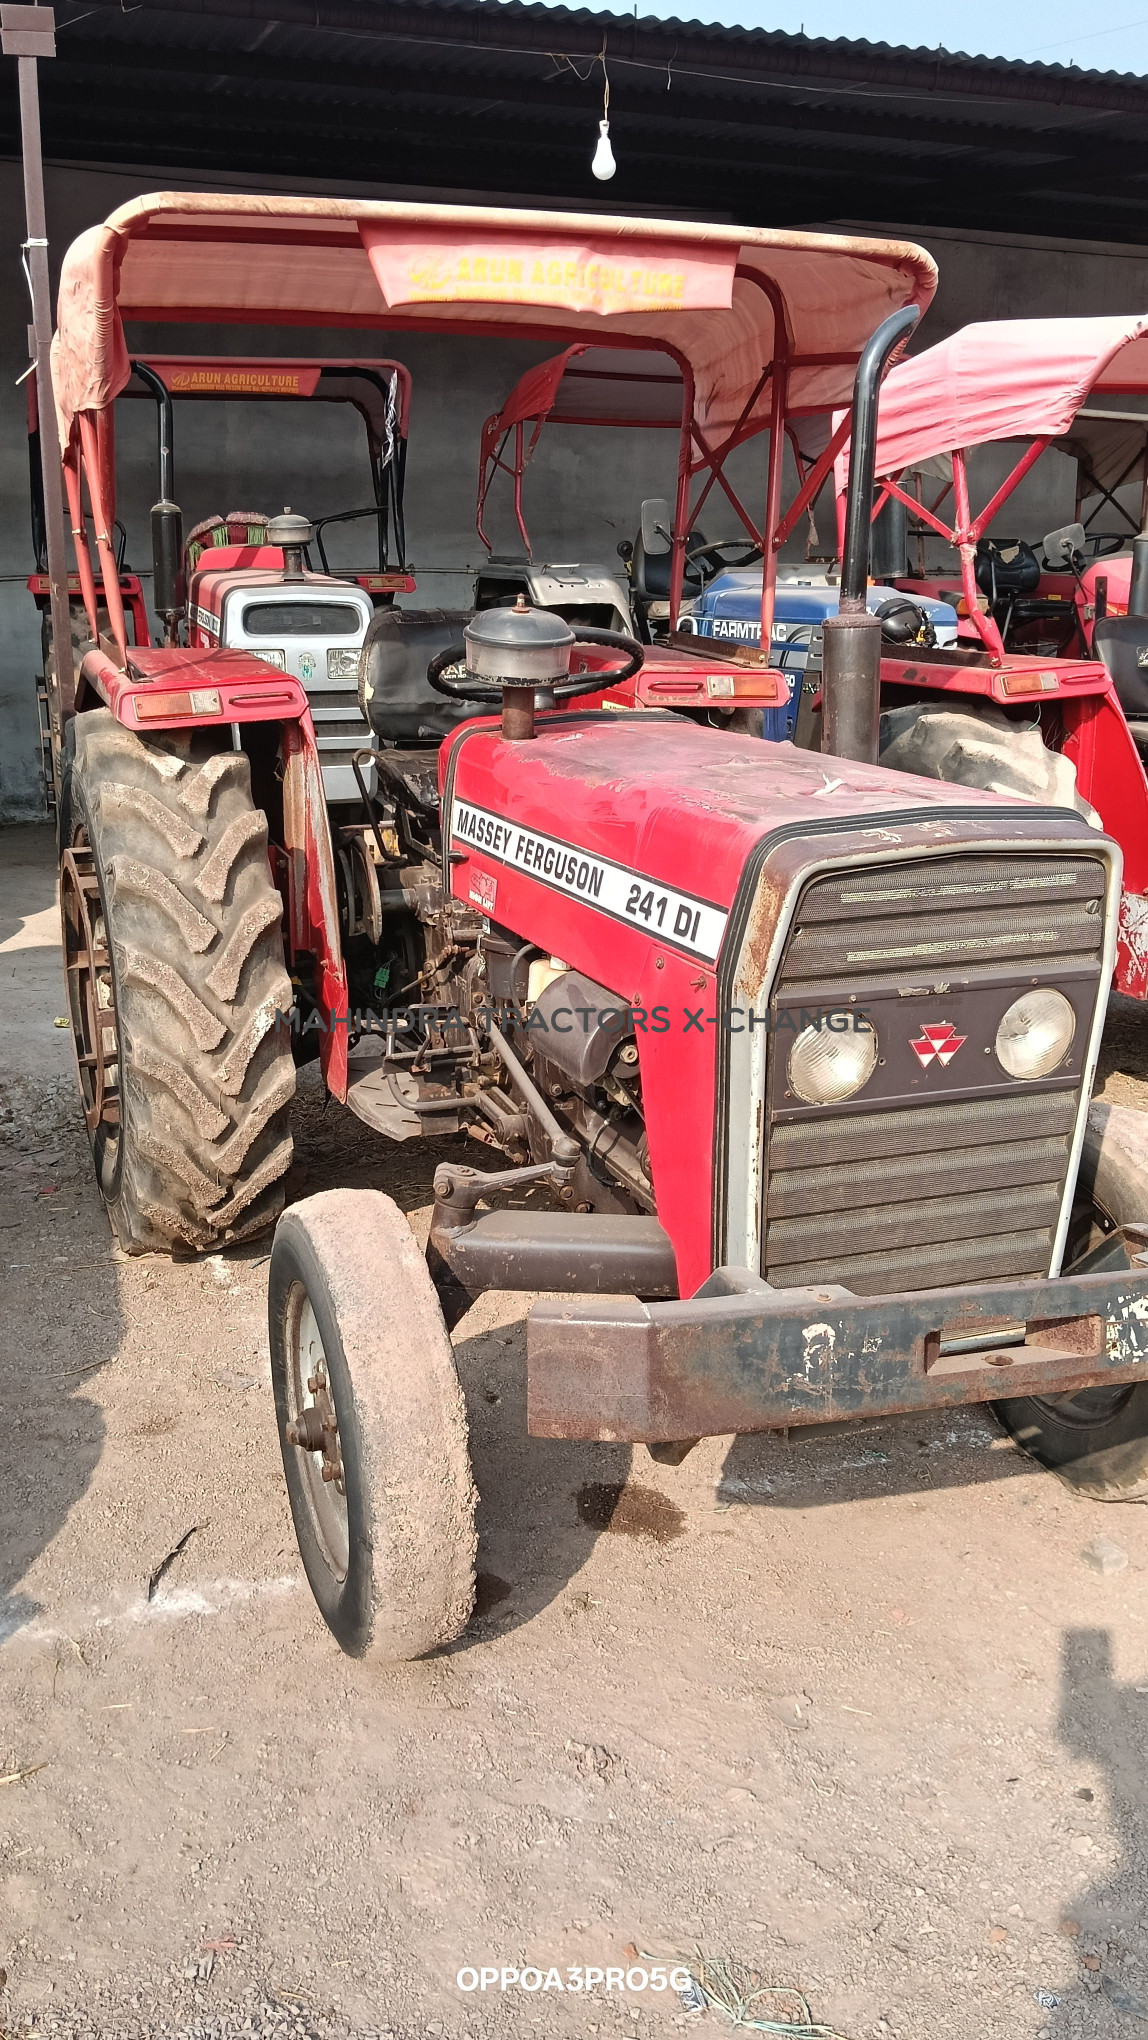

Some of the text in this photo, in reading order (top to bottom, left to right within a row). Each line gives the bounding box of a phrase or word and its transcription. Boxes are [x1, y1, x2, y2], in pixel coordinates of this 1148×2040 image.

[457, 256, 523, 283] ARUN
[530, 259, 686, 299] AGRICULTURE
[192, 372, 299, 387] ARUN AGRICULTURE
[456, 808, 701, 943] MASSEY FERGUSON 241 DI
